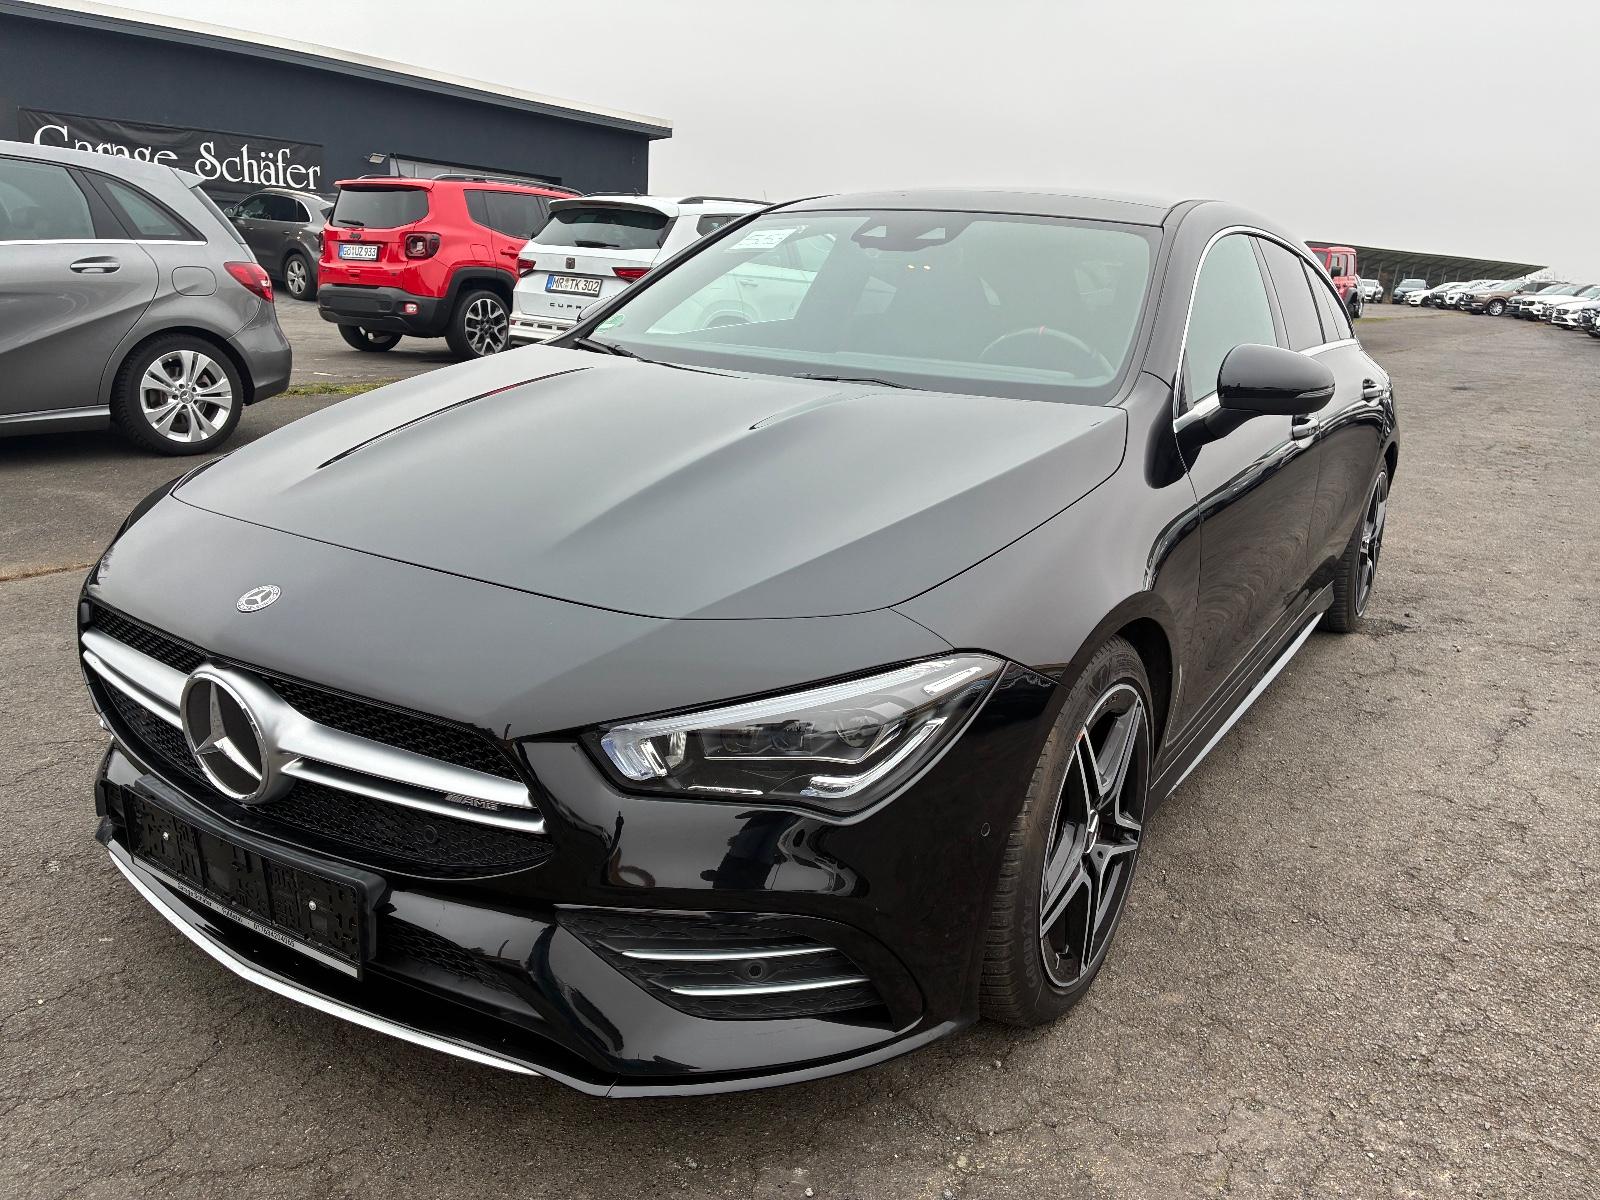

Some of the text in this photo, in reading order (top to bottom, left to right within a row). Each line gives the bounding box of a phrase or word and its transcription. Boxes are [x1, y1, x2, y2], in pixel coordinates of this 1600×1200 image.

[194, 141, 321, 190] Schäfer
[364, 248, 377, 257] 933
[552, 277, 600, 292] MR TK 302
[461, 796, 499, 811] AMG
